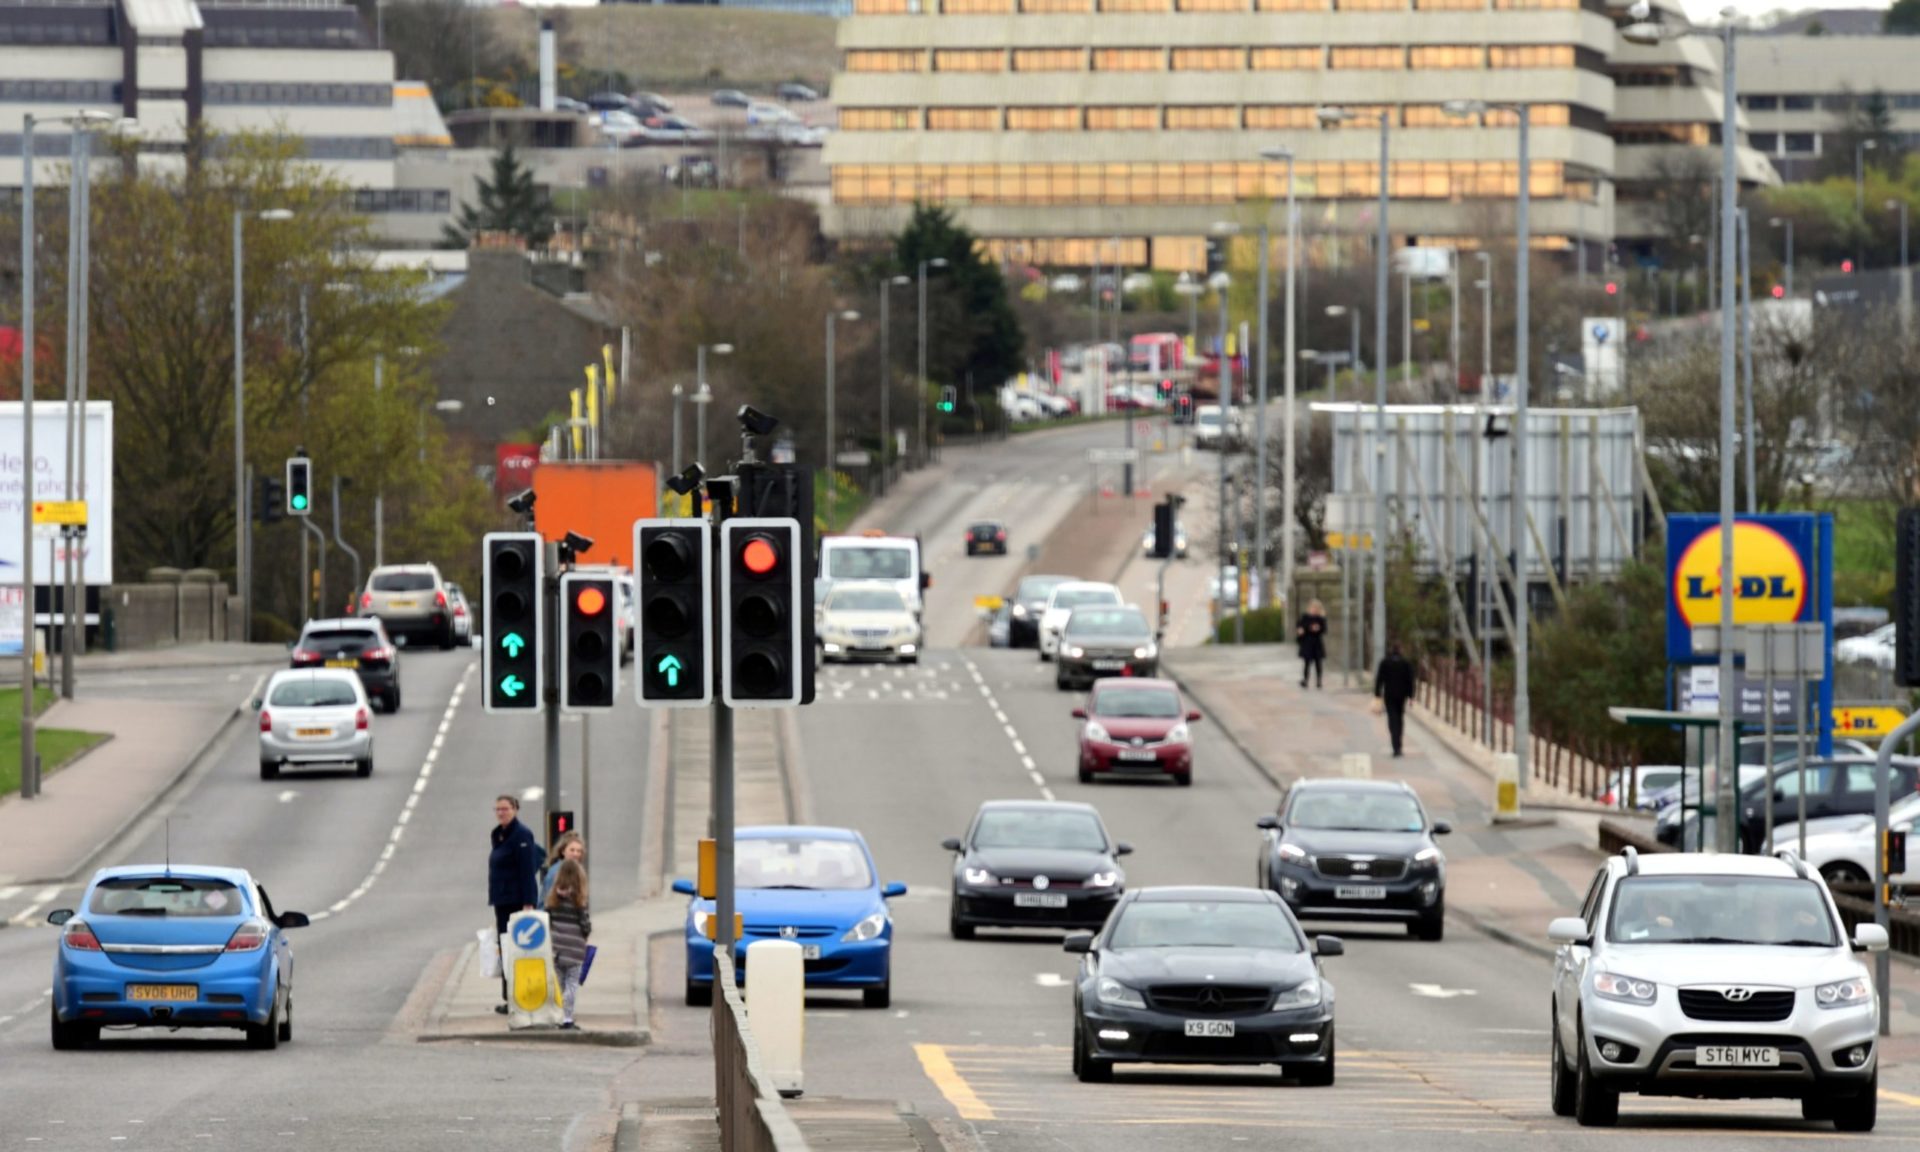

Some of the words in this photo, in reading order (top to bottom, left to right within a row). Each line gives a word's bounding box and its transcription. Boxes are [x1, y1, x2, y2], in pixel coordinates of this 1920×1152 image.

[1187, 1022, 1204, 1034] X9
[1706, 1048, 1738, 1063] ST61
[1742, 1048, 1771, 1063] MYC
